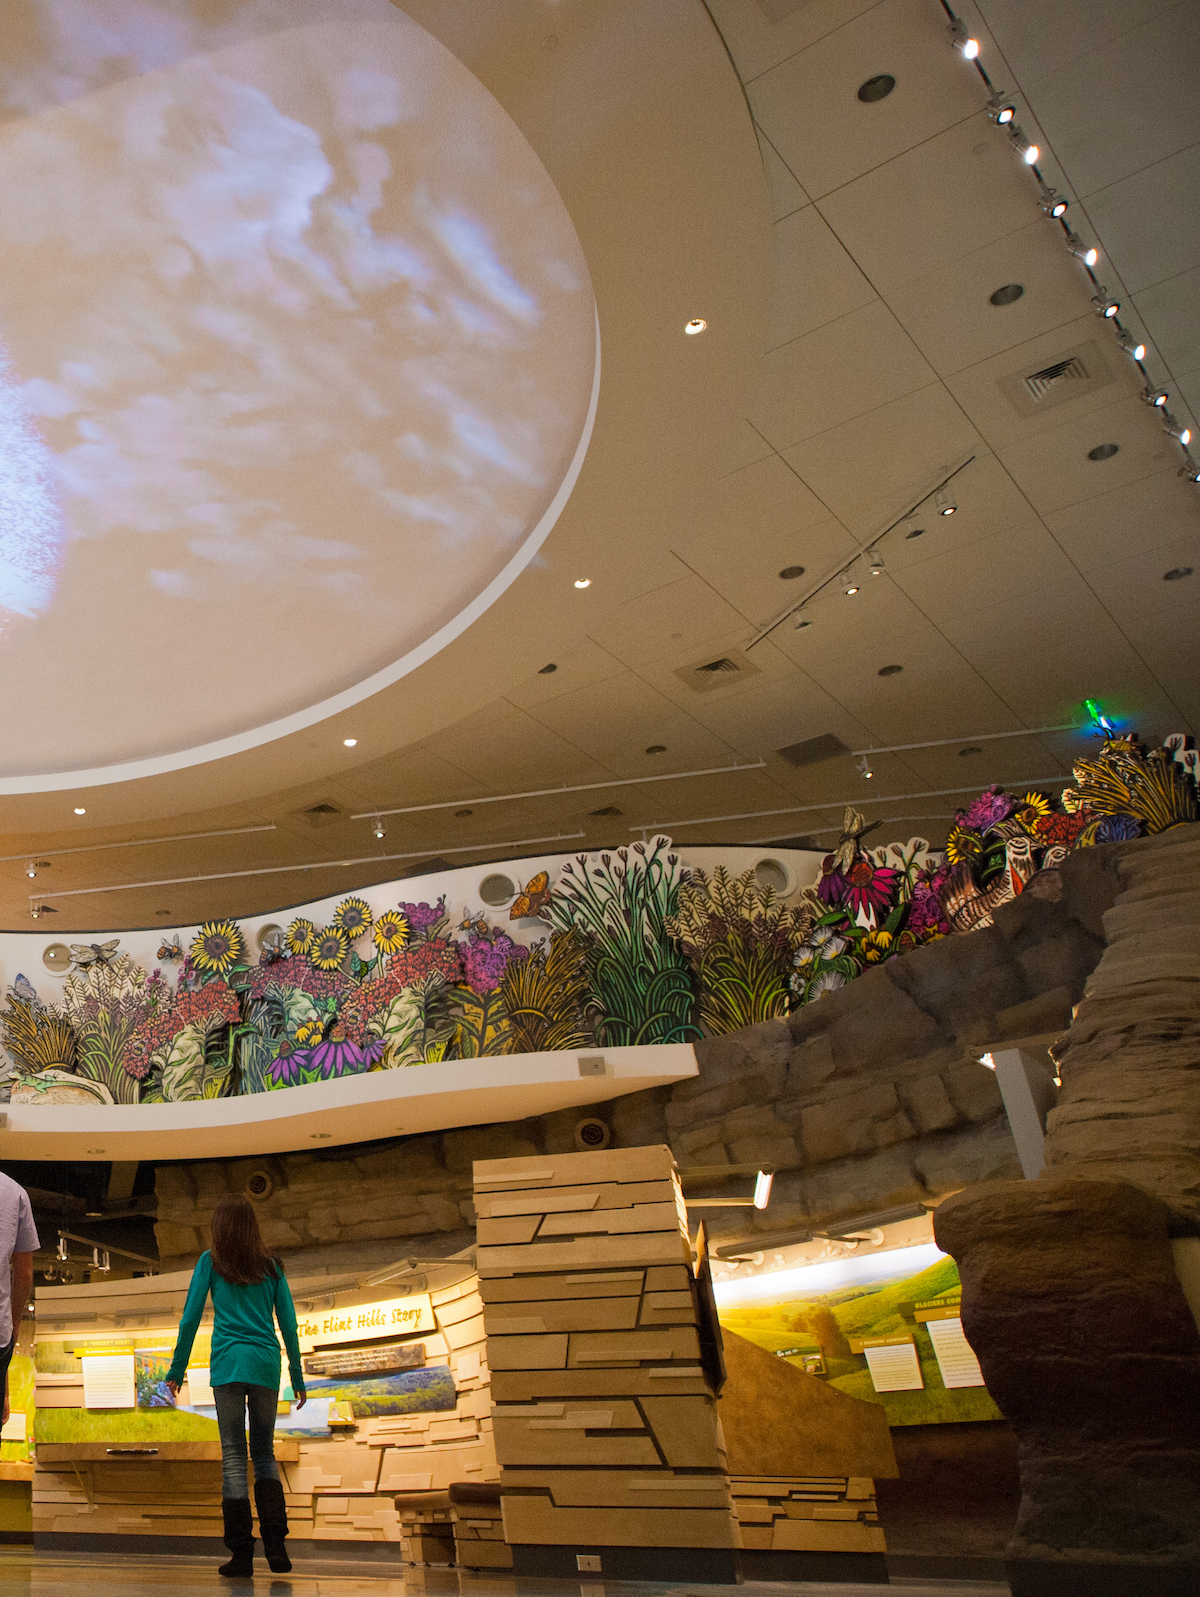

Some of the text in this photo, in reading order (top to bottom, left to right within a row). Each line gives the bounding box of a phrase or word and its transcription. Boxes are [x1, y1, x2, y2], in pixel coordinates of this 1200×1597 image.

[915, 1299, 944, 1309] GLACIERS
[298, 1308, 422, 1337] The Flint Hills Story
